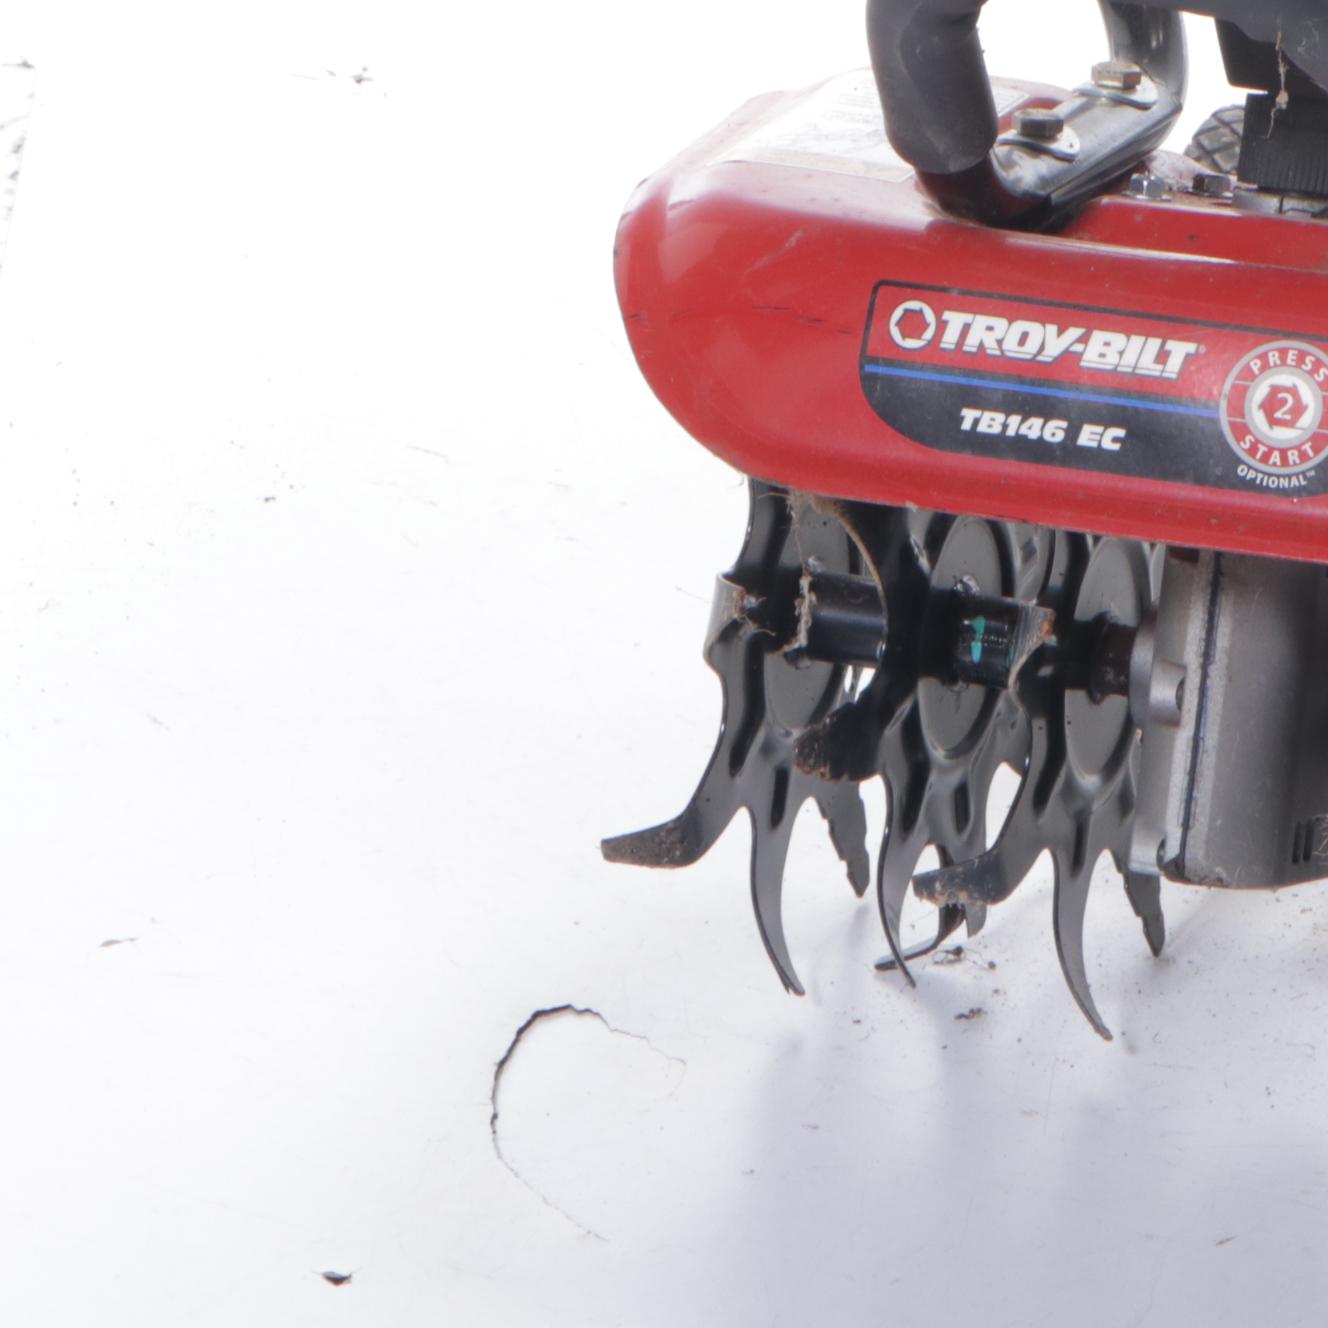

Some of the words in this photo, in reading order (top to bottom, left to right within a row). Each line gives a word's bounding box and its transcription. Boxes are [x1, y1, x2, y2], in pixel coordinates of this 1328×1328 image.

[939, 309, 1199, 380] TROY-BILT
[1273, 392, 1294, 420] 2
[959, 407, 1067, 443] TB146
[1077, 424, 1127, 452] EC
[1239, 434, 1316, 467] START
